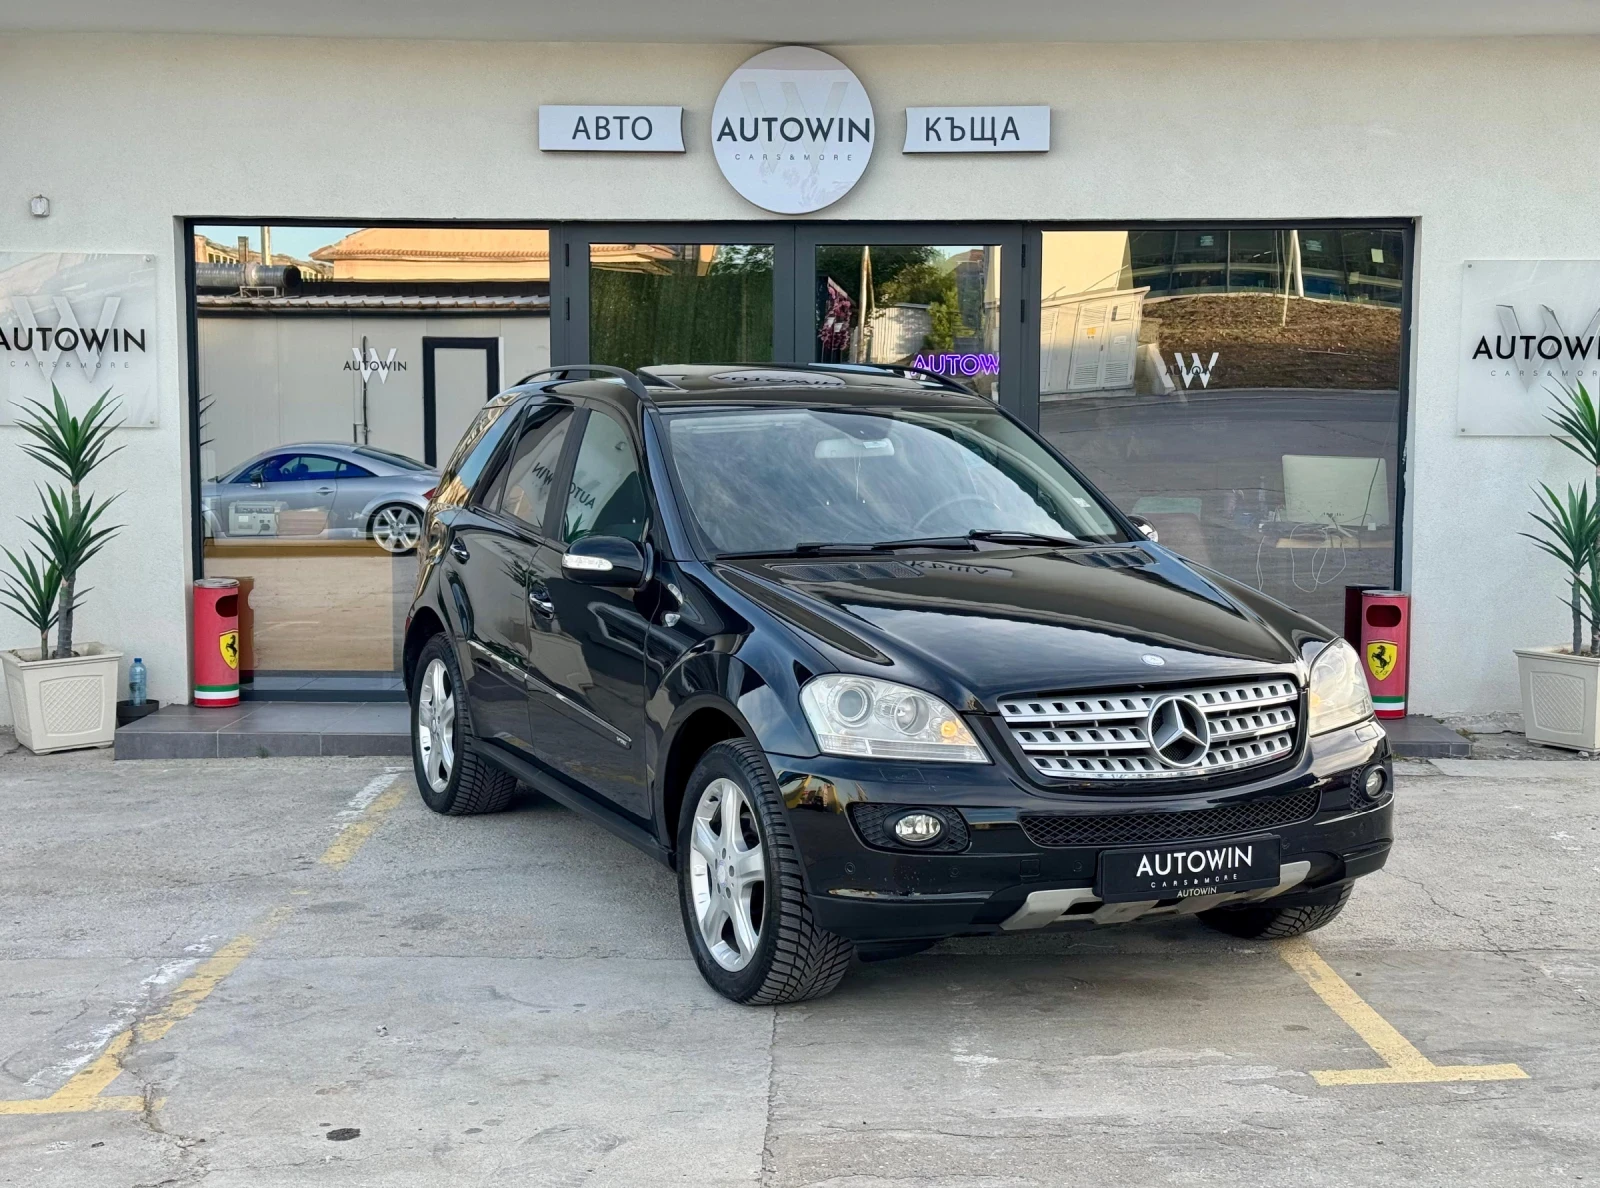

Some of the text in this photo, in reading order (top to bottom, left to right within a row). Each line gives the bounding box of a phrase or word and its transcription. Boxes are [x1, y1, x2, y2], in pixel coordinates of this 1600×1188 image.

[572, 115, 653, 141] АВТО
[716, 116, 871, 143] AUTOWIN
[925, 116, 1021, 146] КЪЩА
[735, 153, 853, 161] CARS&MORE
[10, 360, 130, 369] CARS&MORE
[343, 360, 407, 372] AUTOWIN
[1136, 845, 1253, 877] AUTOWIN
[1150, 873, 1238, 888] CARS&MORE
[1177, 886, 1217, 898] AUTOWIN
